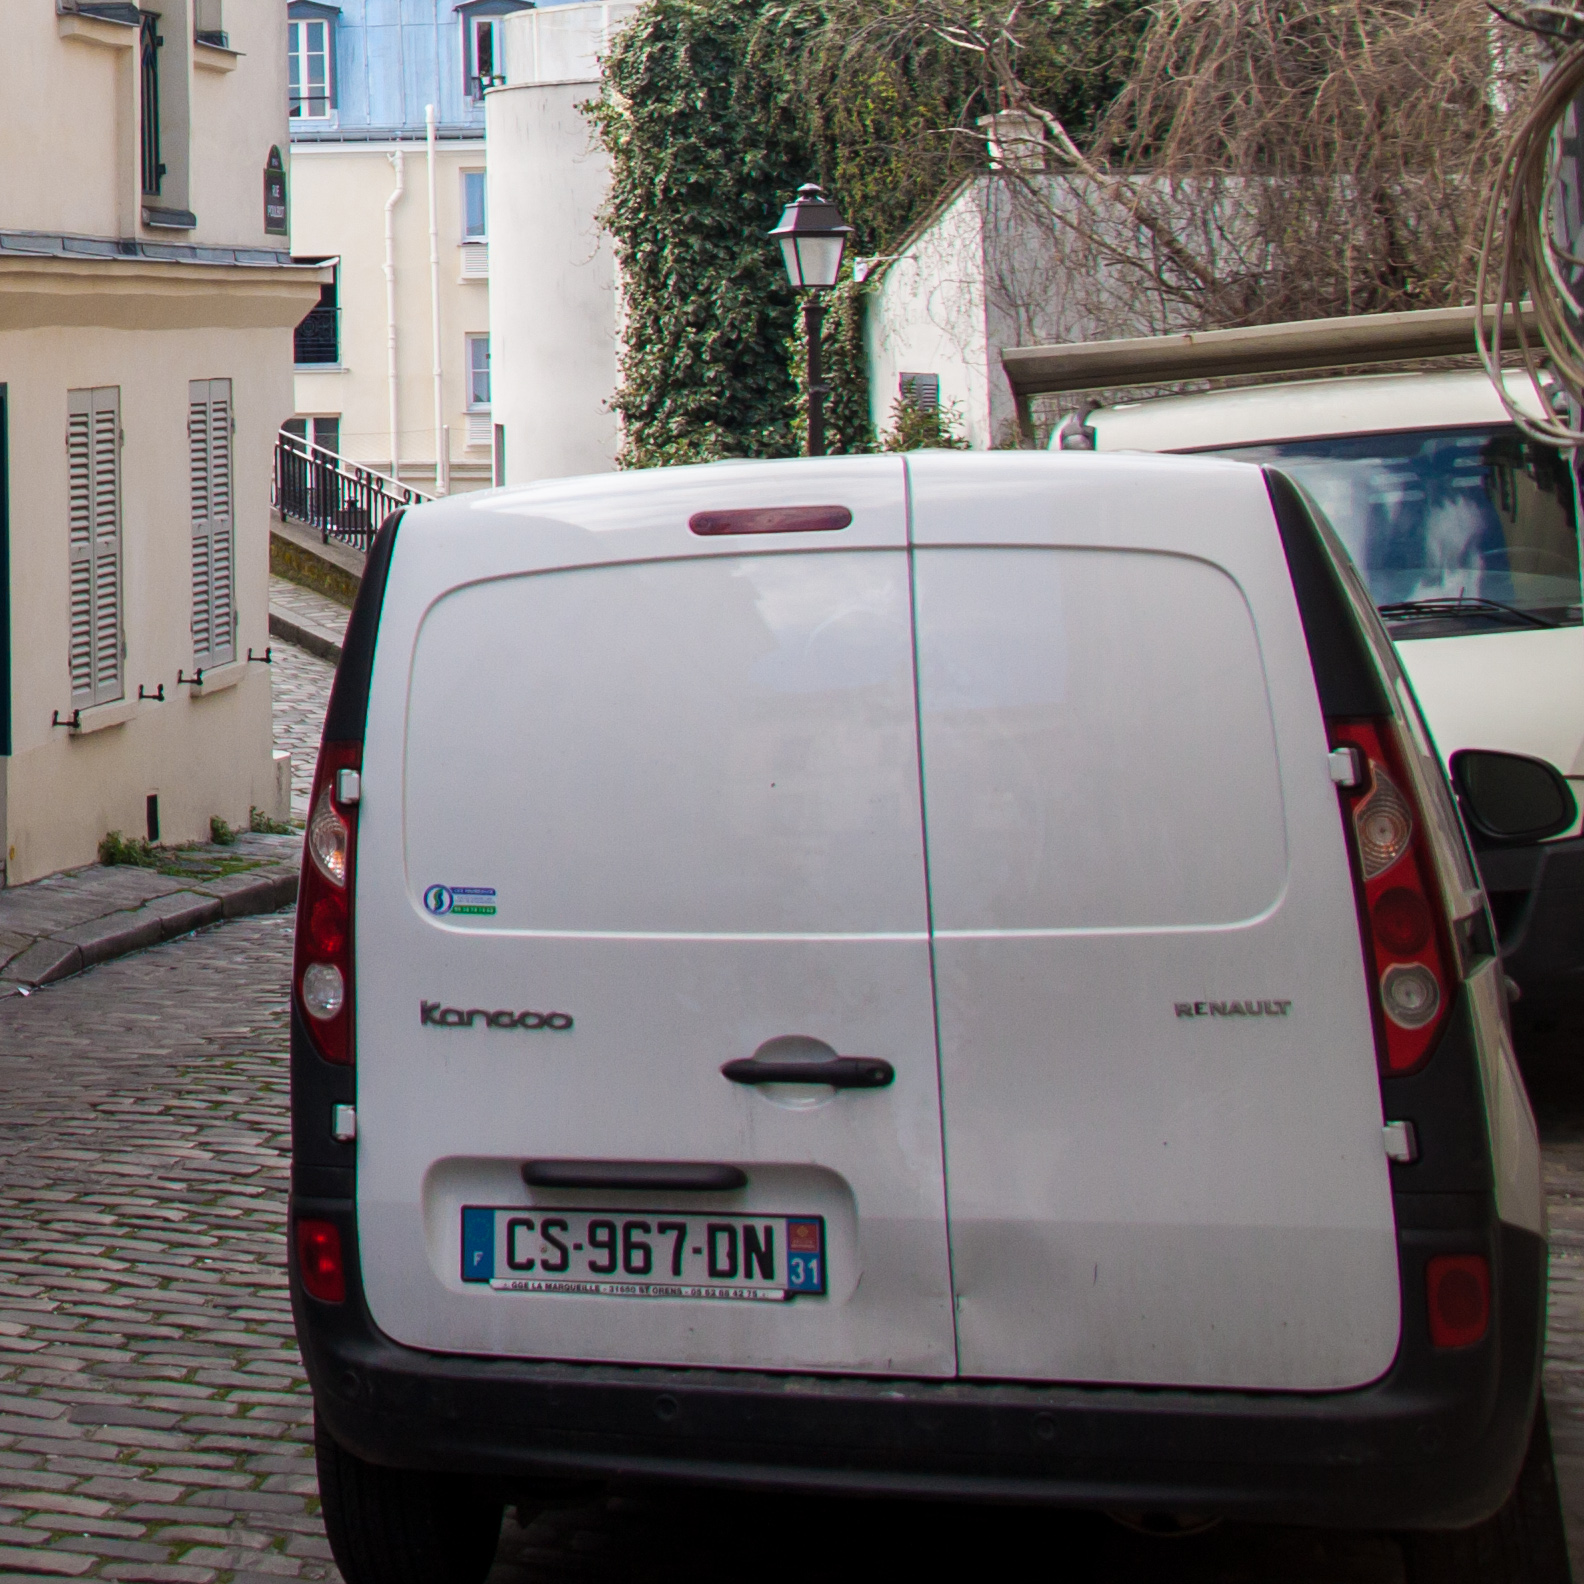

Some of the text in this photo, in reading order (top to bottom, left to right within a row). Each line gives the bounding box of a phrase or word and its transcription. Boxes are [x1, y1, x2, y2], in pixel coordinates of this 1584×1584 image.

[419, 999, 574, 1030] Kangoo
[1173, 1000, 1292, 1018] RENAULT
[473, 1216, 819, 1286] F CS-967-DN 31
